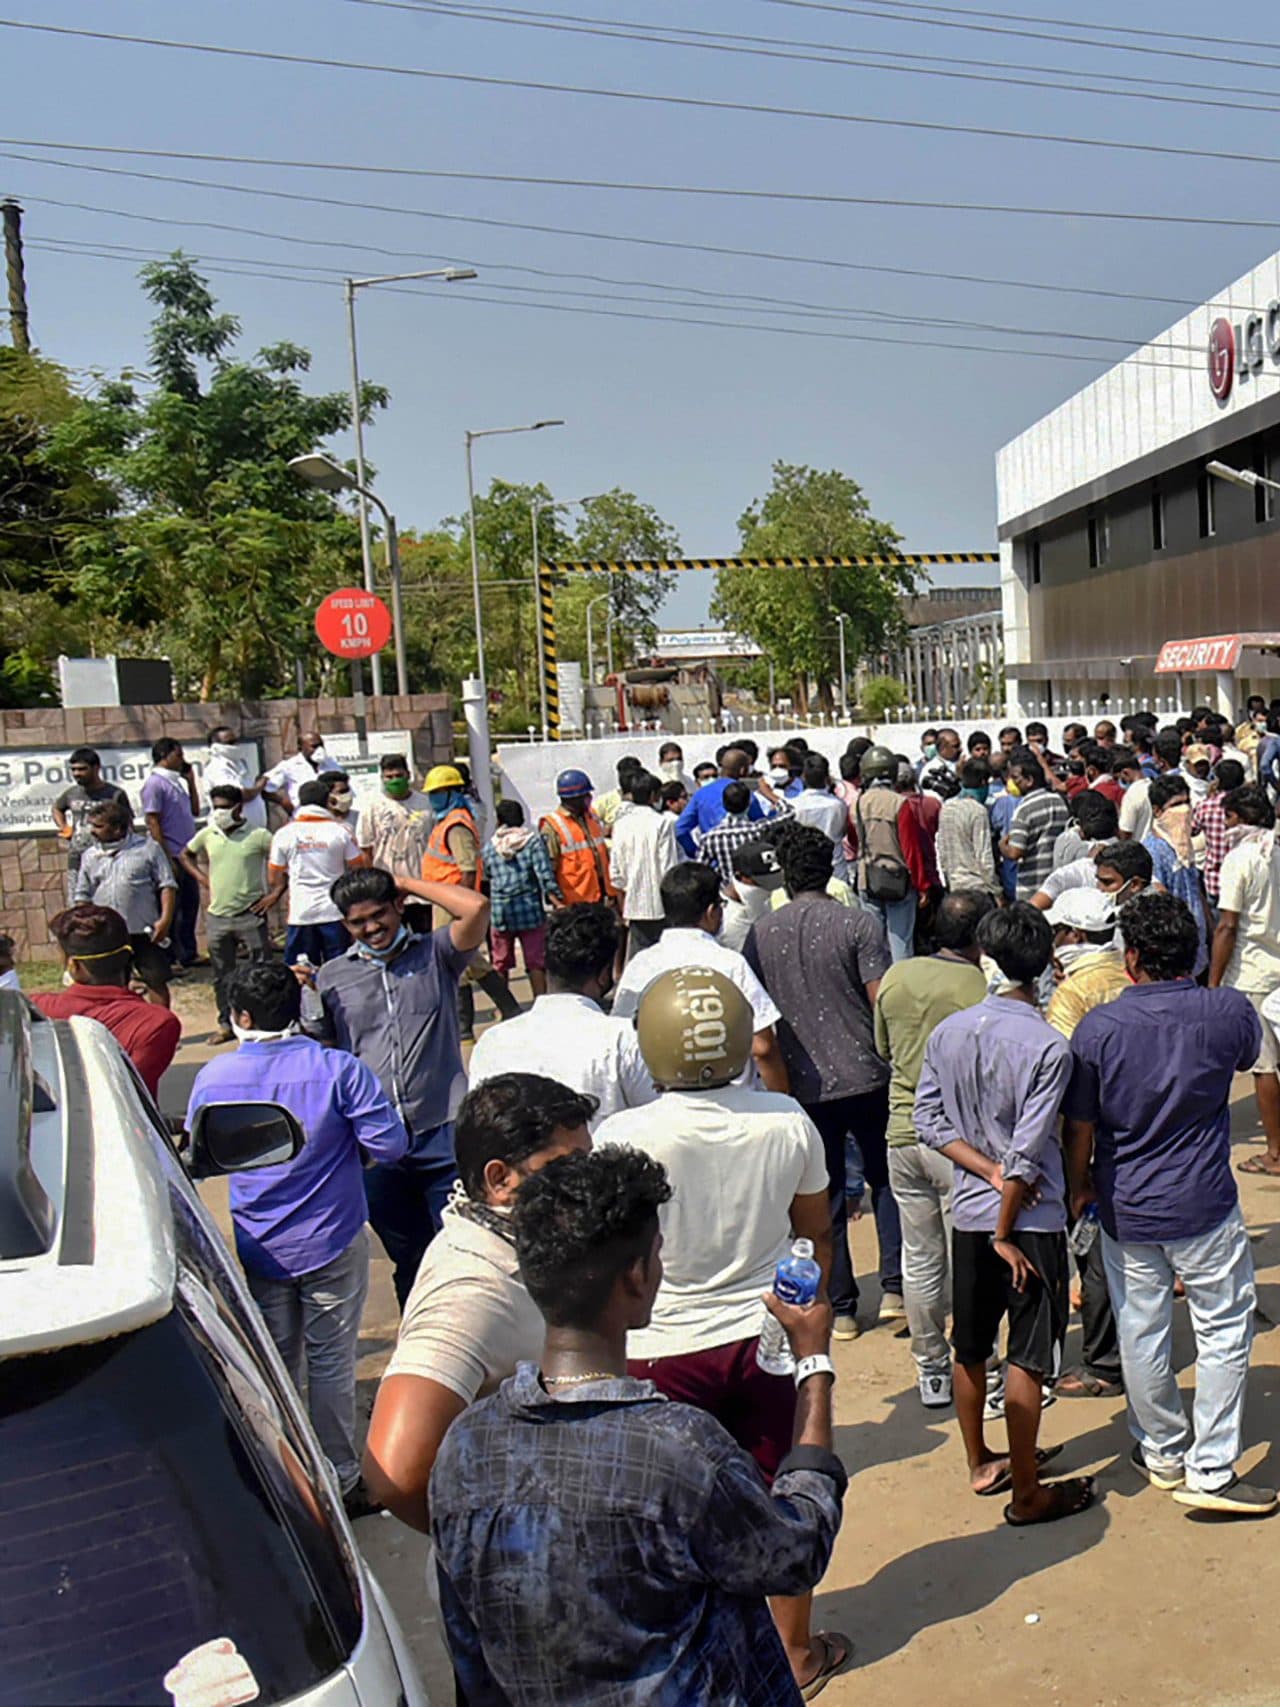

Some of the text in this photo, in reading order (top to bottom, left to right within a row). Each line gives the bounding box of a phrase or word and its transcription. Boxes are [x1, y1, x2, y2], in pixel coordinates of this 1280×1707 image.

[1234, 313, 1263, 380] LG
[341, 612, 369, 636] 10
[341, 637, 372, 648] KMPH
[1160, 640, 1234, 668] SECURITY
[0, 758, 149, 786] G Polmer
[687, 985, 728, 1061] 1901
